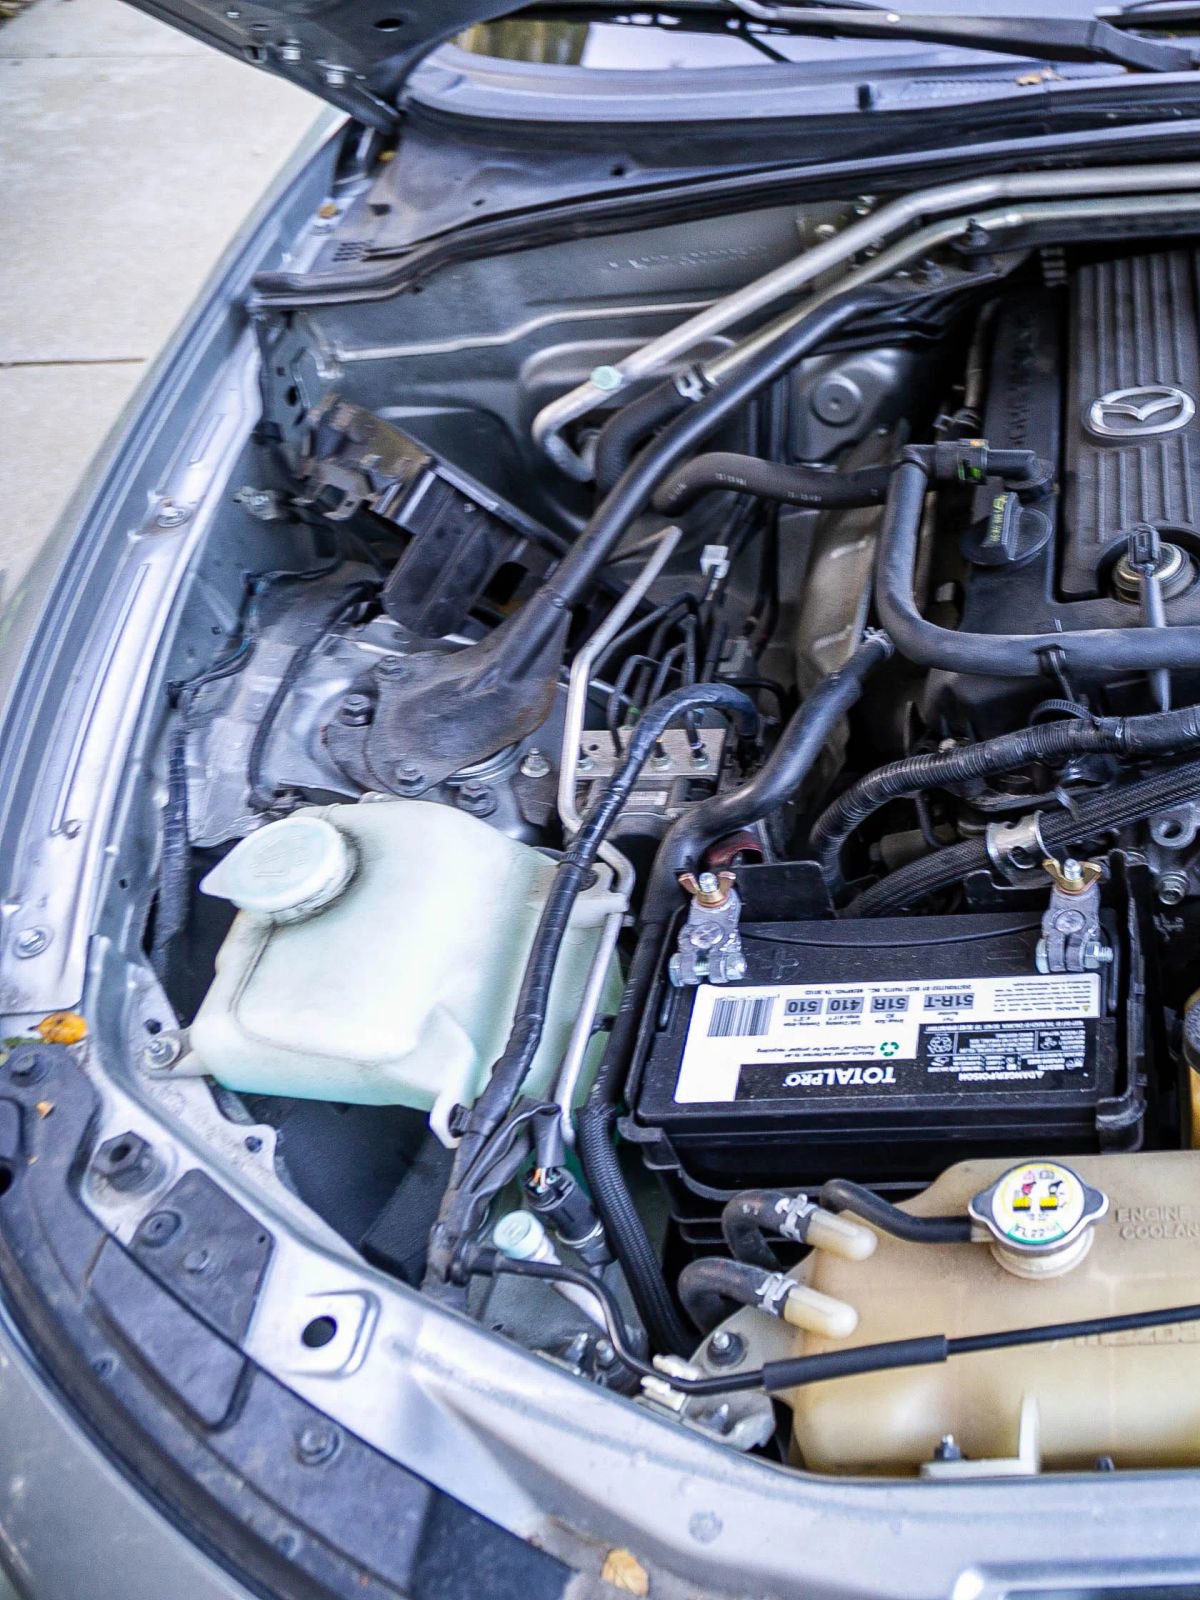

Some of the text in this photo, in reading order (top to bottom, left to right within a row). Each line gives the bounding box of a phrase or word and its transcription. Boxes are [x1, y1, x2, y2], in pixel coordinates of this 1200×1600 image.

[787, 1000, 818, 1013] 510
[829, 999, 861, 1012] 410
[874, 998, 906, 1010] 51R
[924, 994, 974, 1008] 51R-T
[784, 1066, 897, 1087] TOTALPRO
[1115, 1204, 1189, 1222] ENGINE
